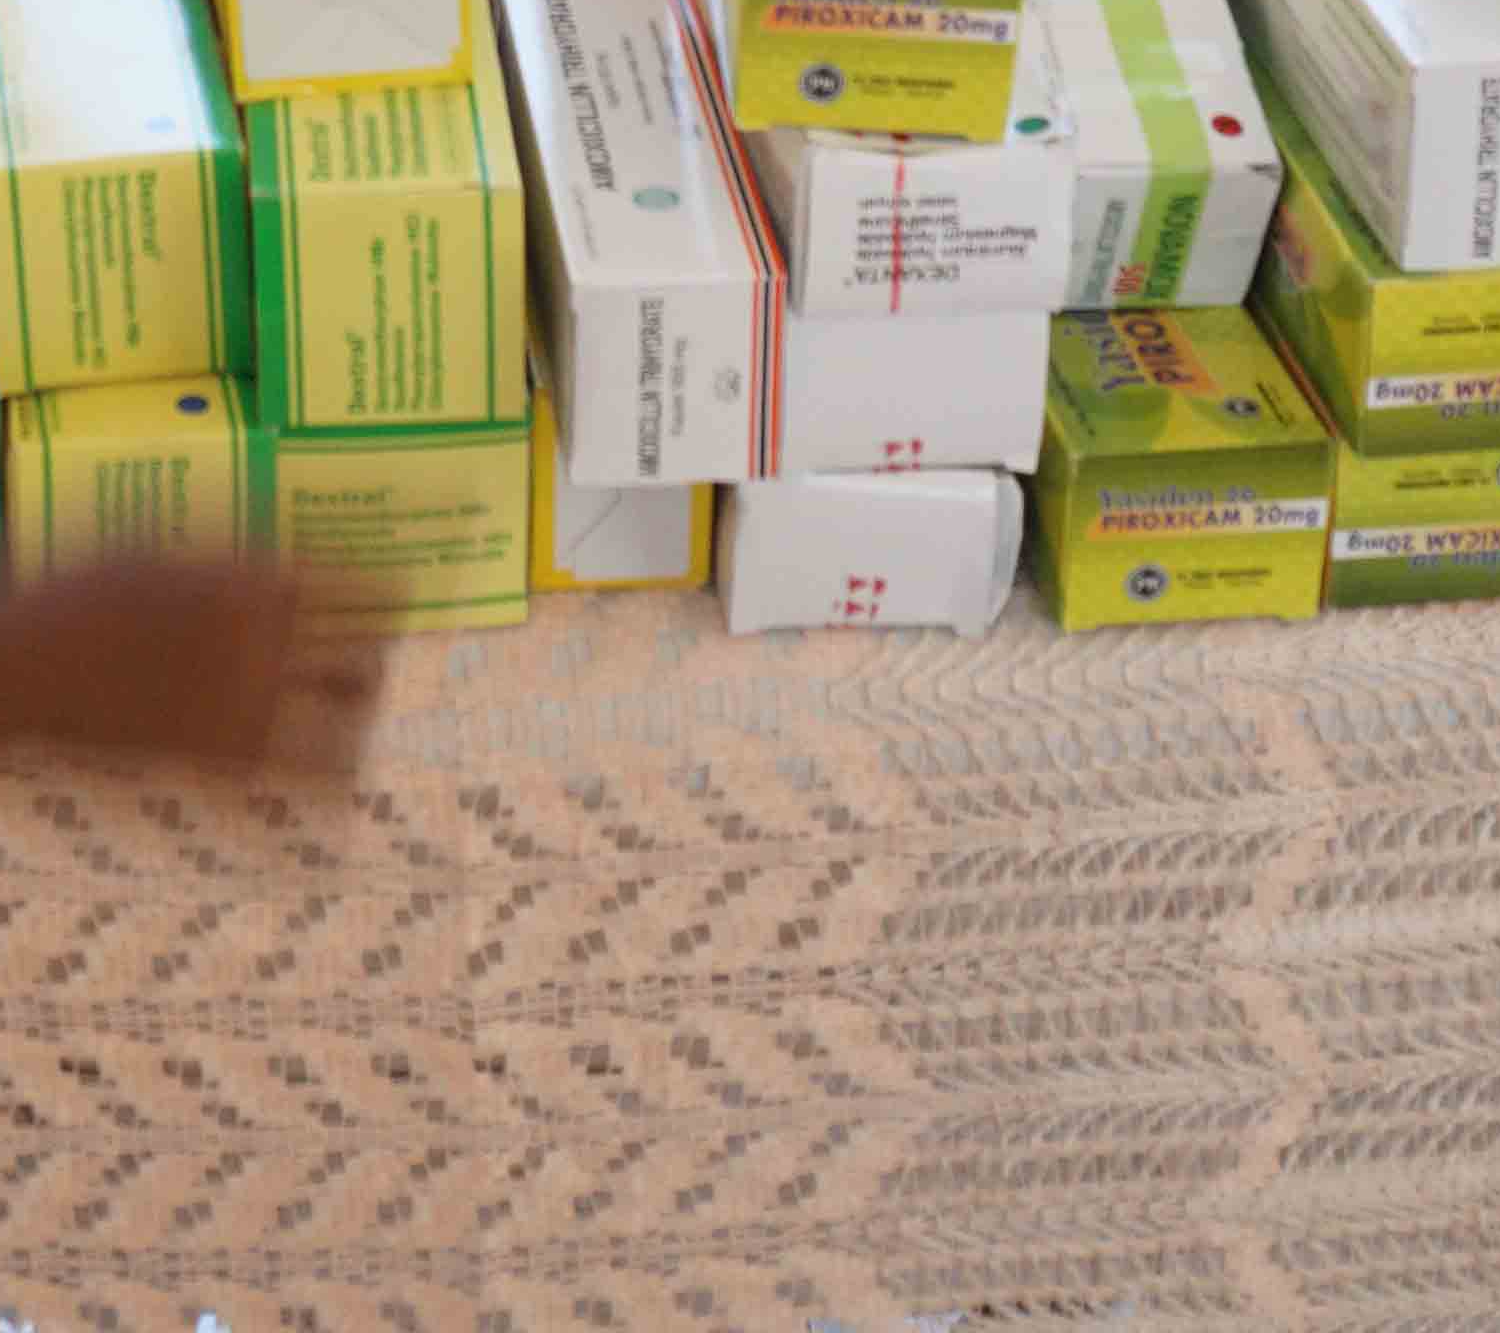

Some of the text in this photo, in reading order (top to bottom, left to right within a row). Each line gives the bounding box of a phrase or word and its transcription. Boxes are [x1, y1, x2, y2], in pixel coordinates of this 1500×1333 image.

[775, 3, 924, 31] PIROXICAM
[1375, 381, 1442, 404] 20mg
[1101, 504, 1320, 531] PIROXICAM 20mg
[1347, 532, 1414, 553] 20mg
